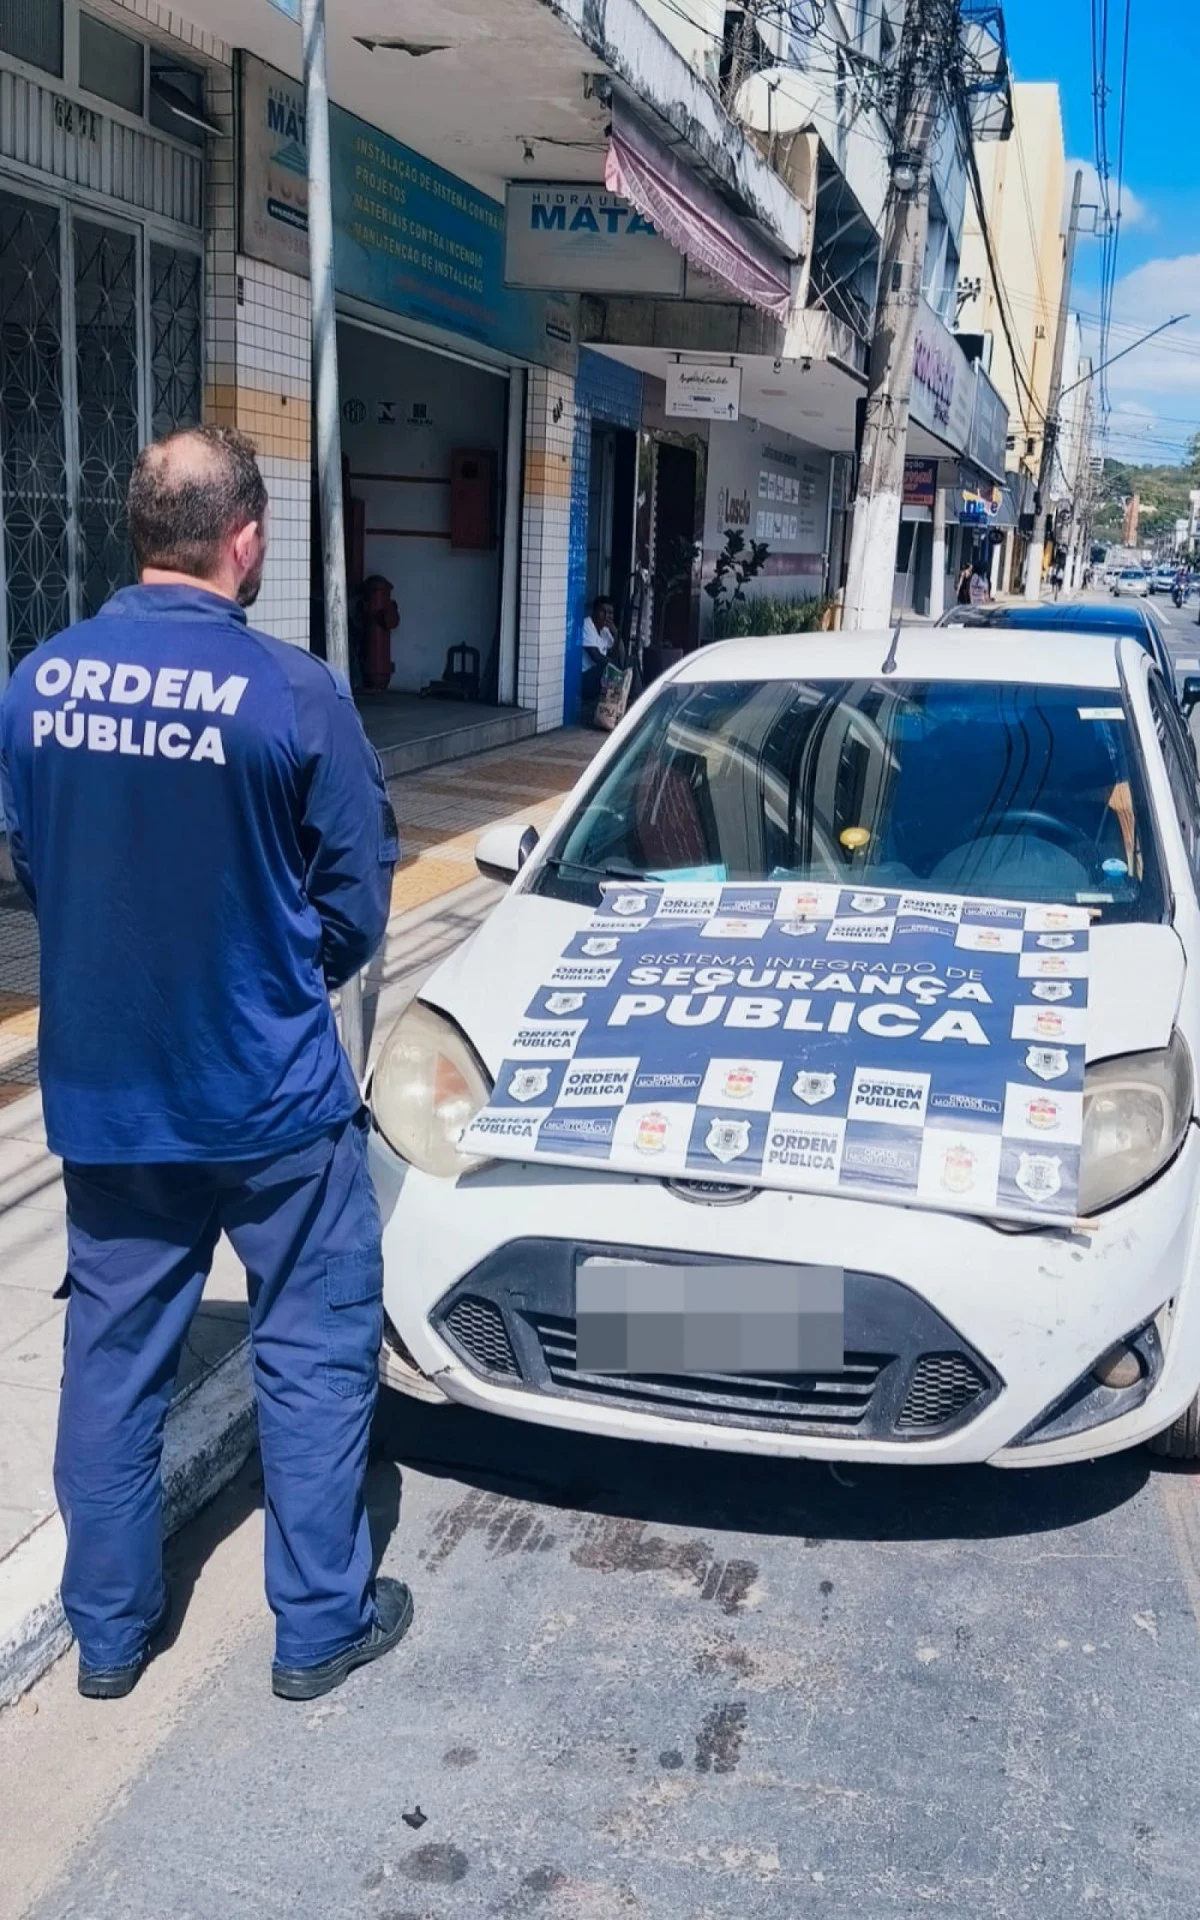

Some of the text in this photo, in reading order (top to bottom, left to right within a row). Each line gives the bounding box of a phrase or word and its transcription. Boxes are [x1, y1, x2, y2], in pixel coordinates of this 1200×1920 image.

[356, 165, 406, 204] PROJETOS
[419, 173, 432, 190] DE
[433, 180, 467, 213] SISTEMA
[532, 191, 631, 207] HIDRÁUL
[353, 193, 407, 232] MATERIAIS
[410, 221, 444, 249] CONTRA
[420, 253, 433, 270] DE
[35, 657, 249, 715] ORDEM
[33, 699, 226, 765] PÚBLICA
[627, 967, 994, 1006] SEGURANÇA
[638, 953, 983, 981] SISTEMA INTEGRADO DE
[607, 984, 991, 1046] PÚBLICA
[568, 1072, 629, 1084] ORDEM
[857, 1083, 923, 1100] ORDEM
[771, 1134, 837, 1154] ORDEM
